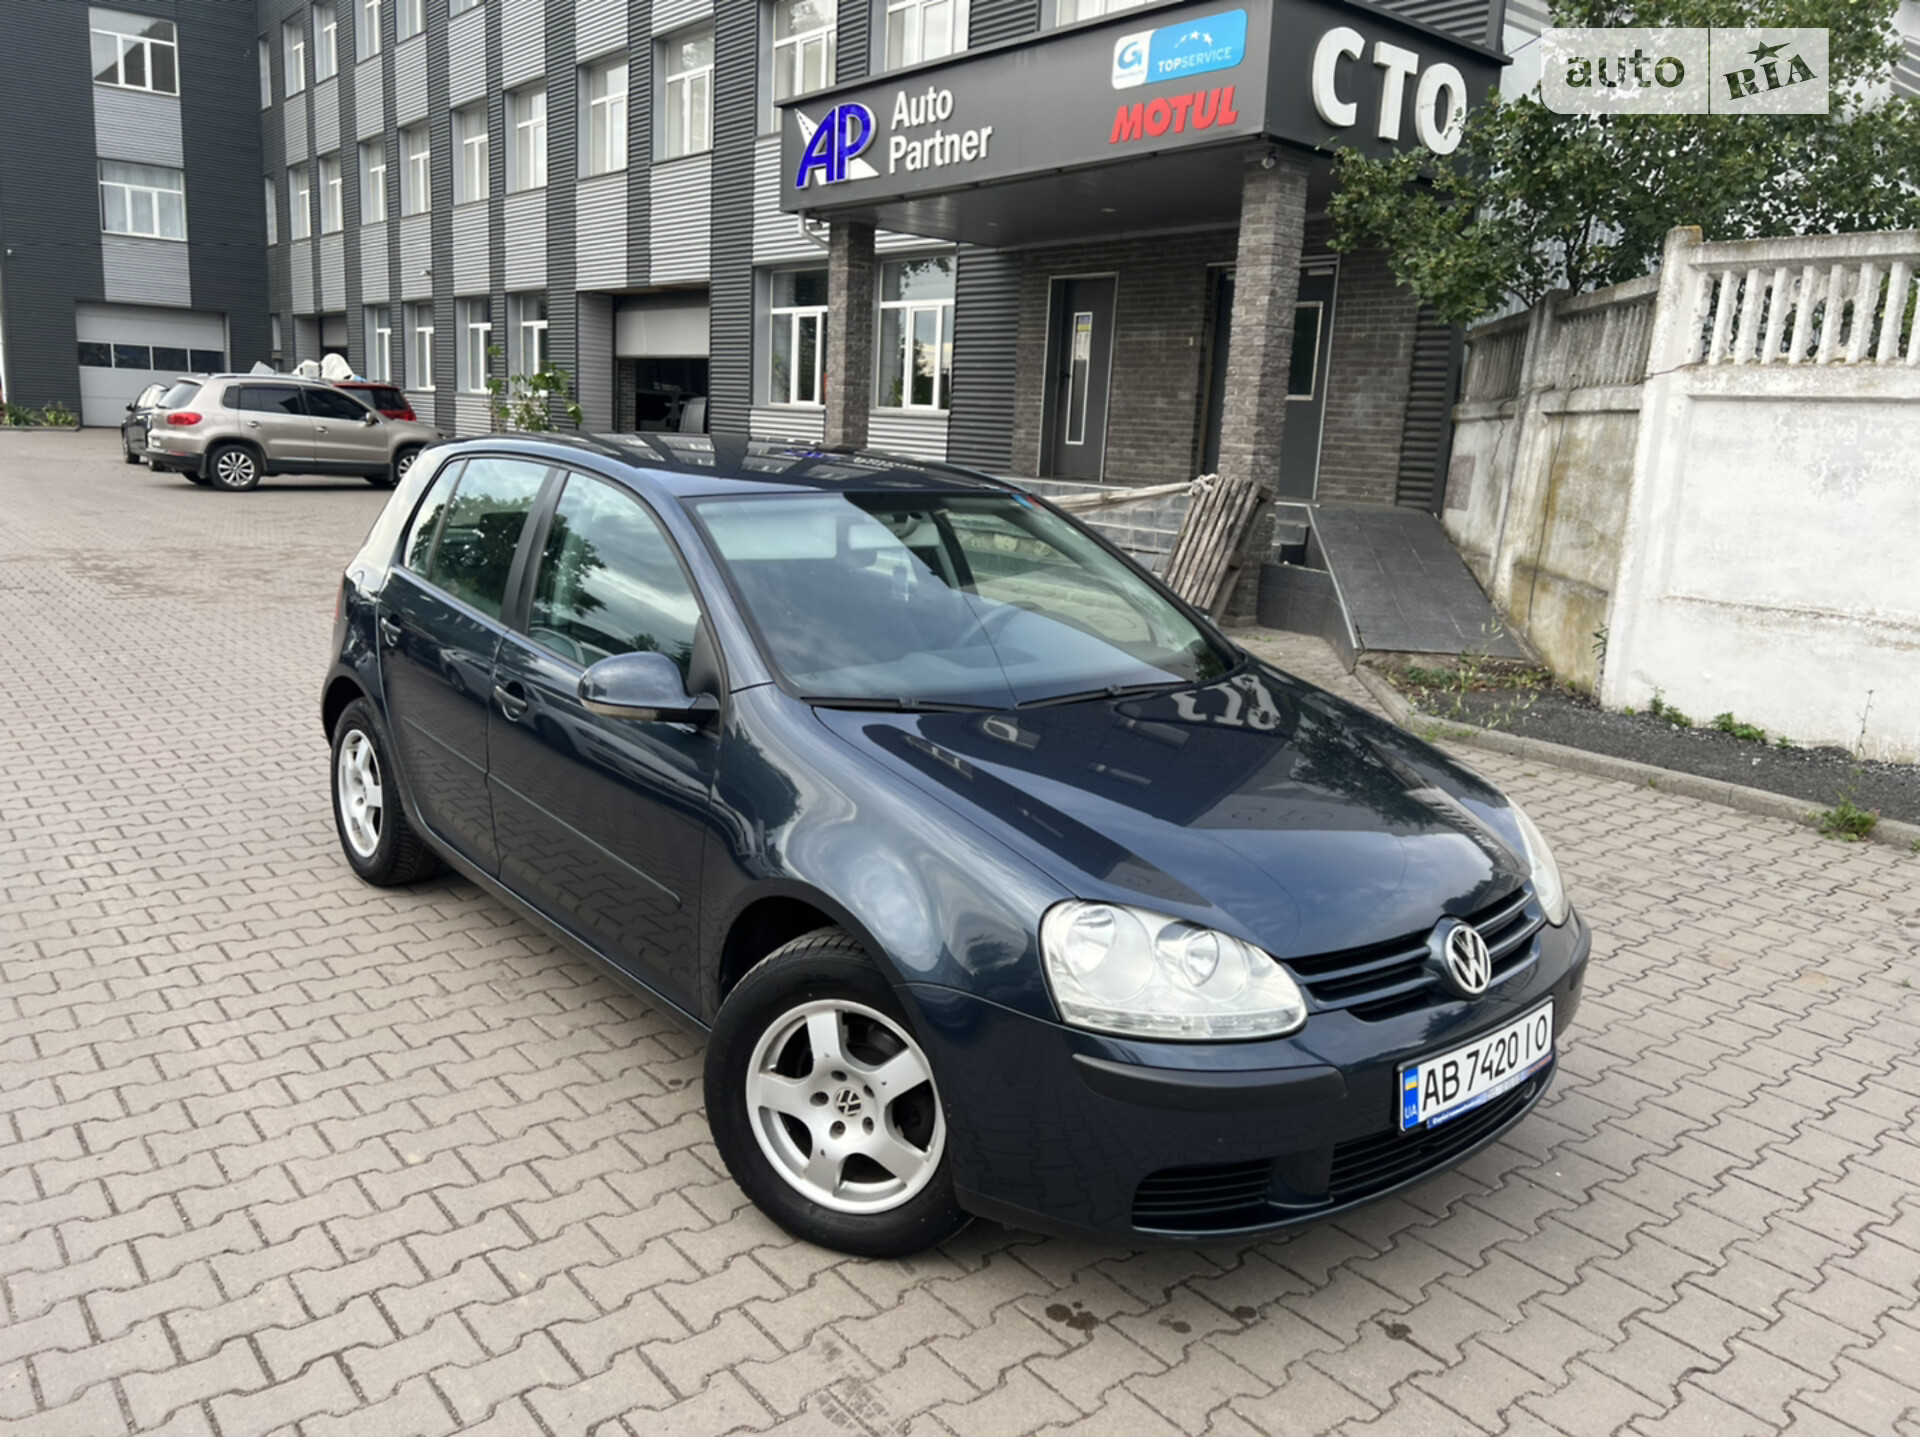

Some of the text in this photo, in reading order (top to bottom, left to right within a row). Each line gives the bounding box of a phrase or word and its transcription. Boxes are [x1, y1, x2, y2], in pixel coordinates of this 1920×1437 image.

[891, 86, 953, 131] Auto
[1109, 85, 1238, 144] MOTUL
[795, 102, 876, 189] AP
[889, 126, 993, 174] Partner
[1422, 1060, 1460, 1111] AB
[1467, 1031, 1518, 1091] 7420
[1405, 1104, 1418, 1119] UA
